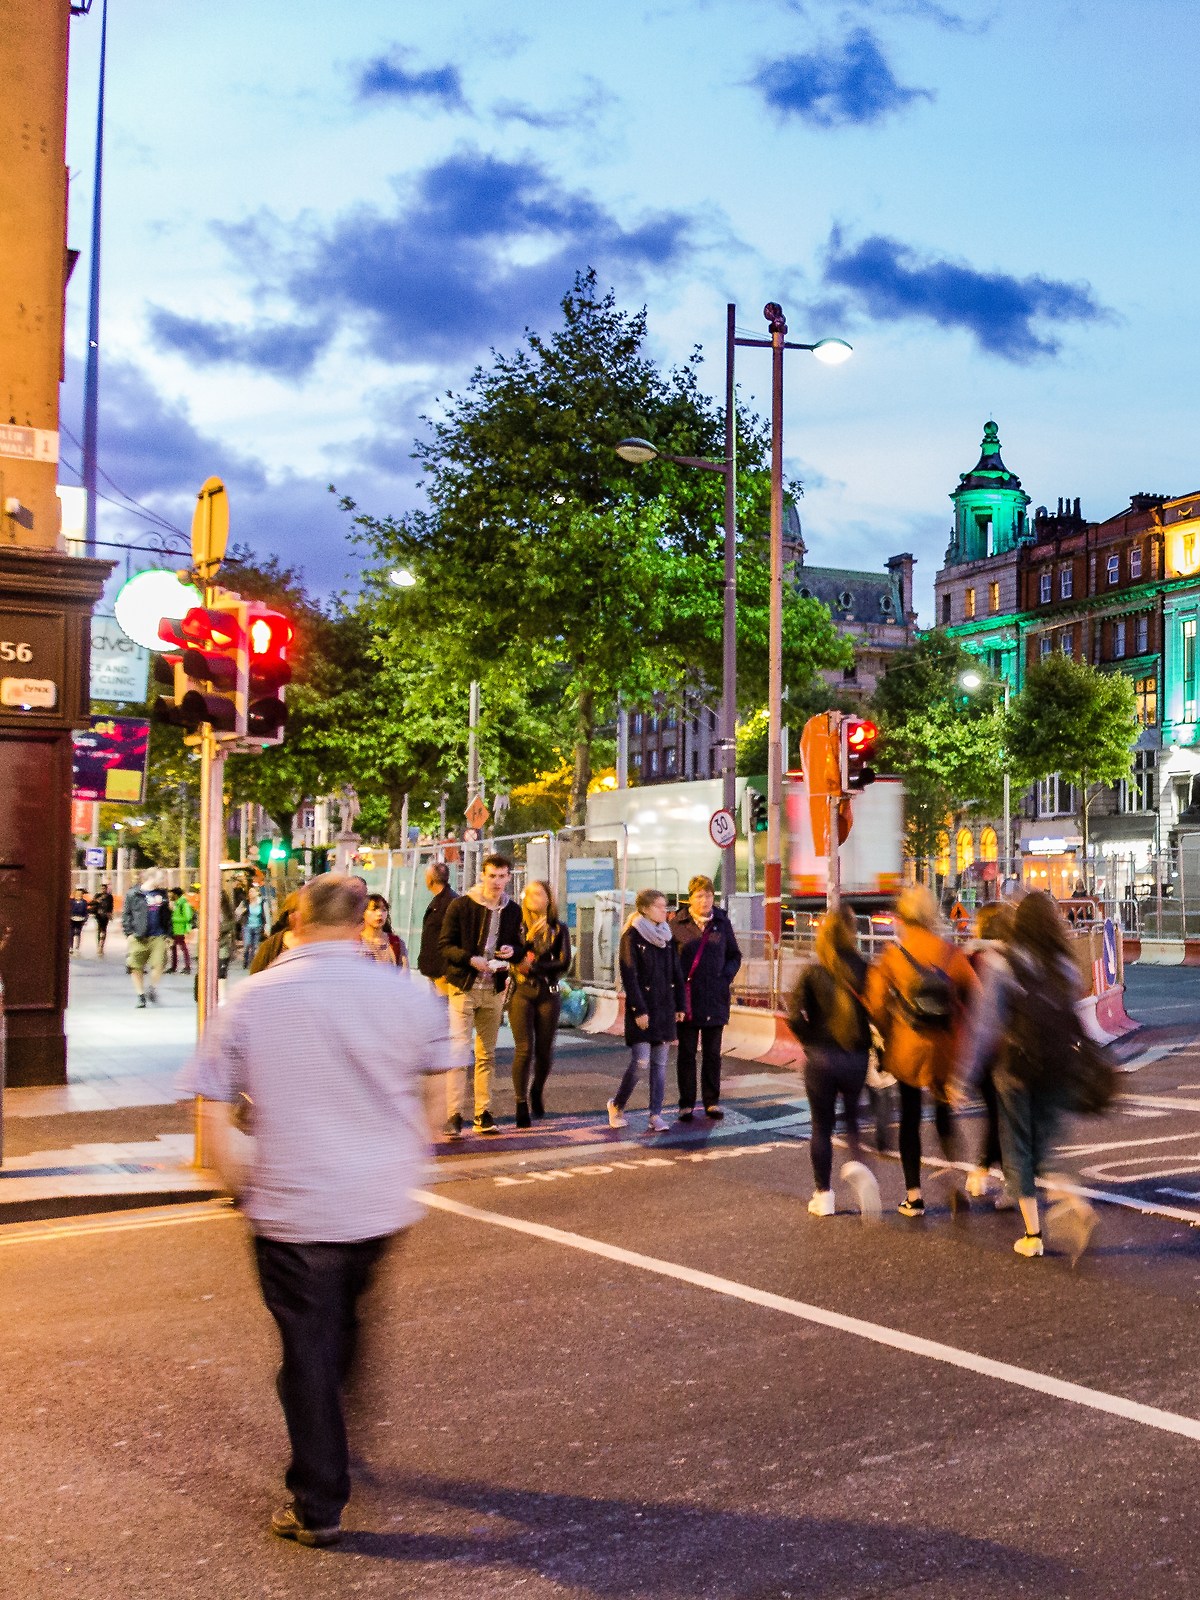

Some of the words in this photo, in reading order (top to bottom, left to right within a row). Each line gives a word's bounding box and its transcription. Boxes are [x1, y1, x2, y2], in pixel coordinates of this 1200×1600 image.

[43, 439, 49, 453] 1
[106, 665, 129, 674] AND
[99, 675, 136, 686] CLINIC
[714, 815, 728, 834] 30
[492, 1156, 677, 1187] RIGHT
